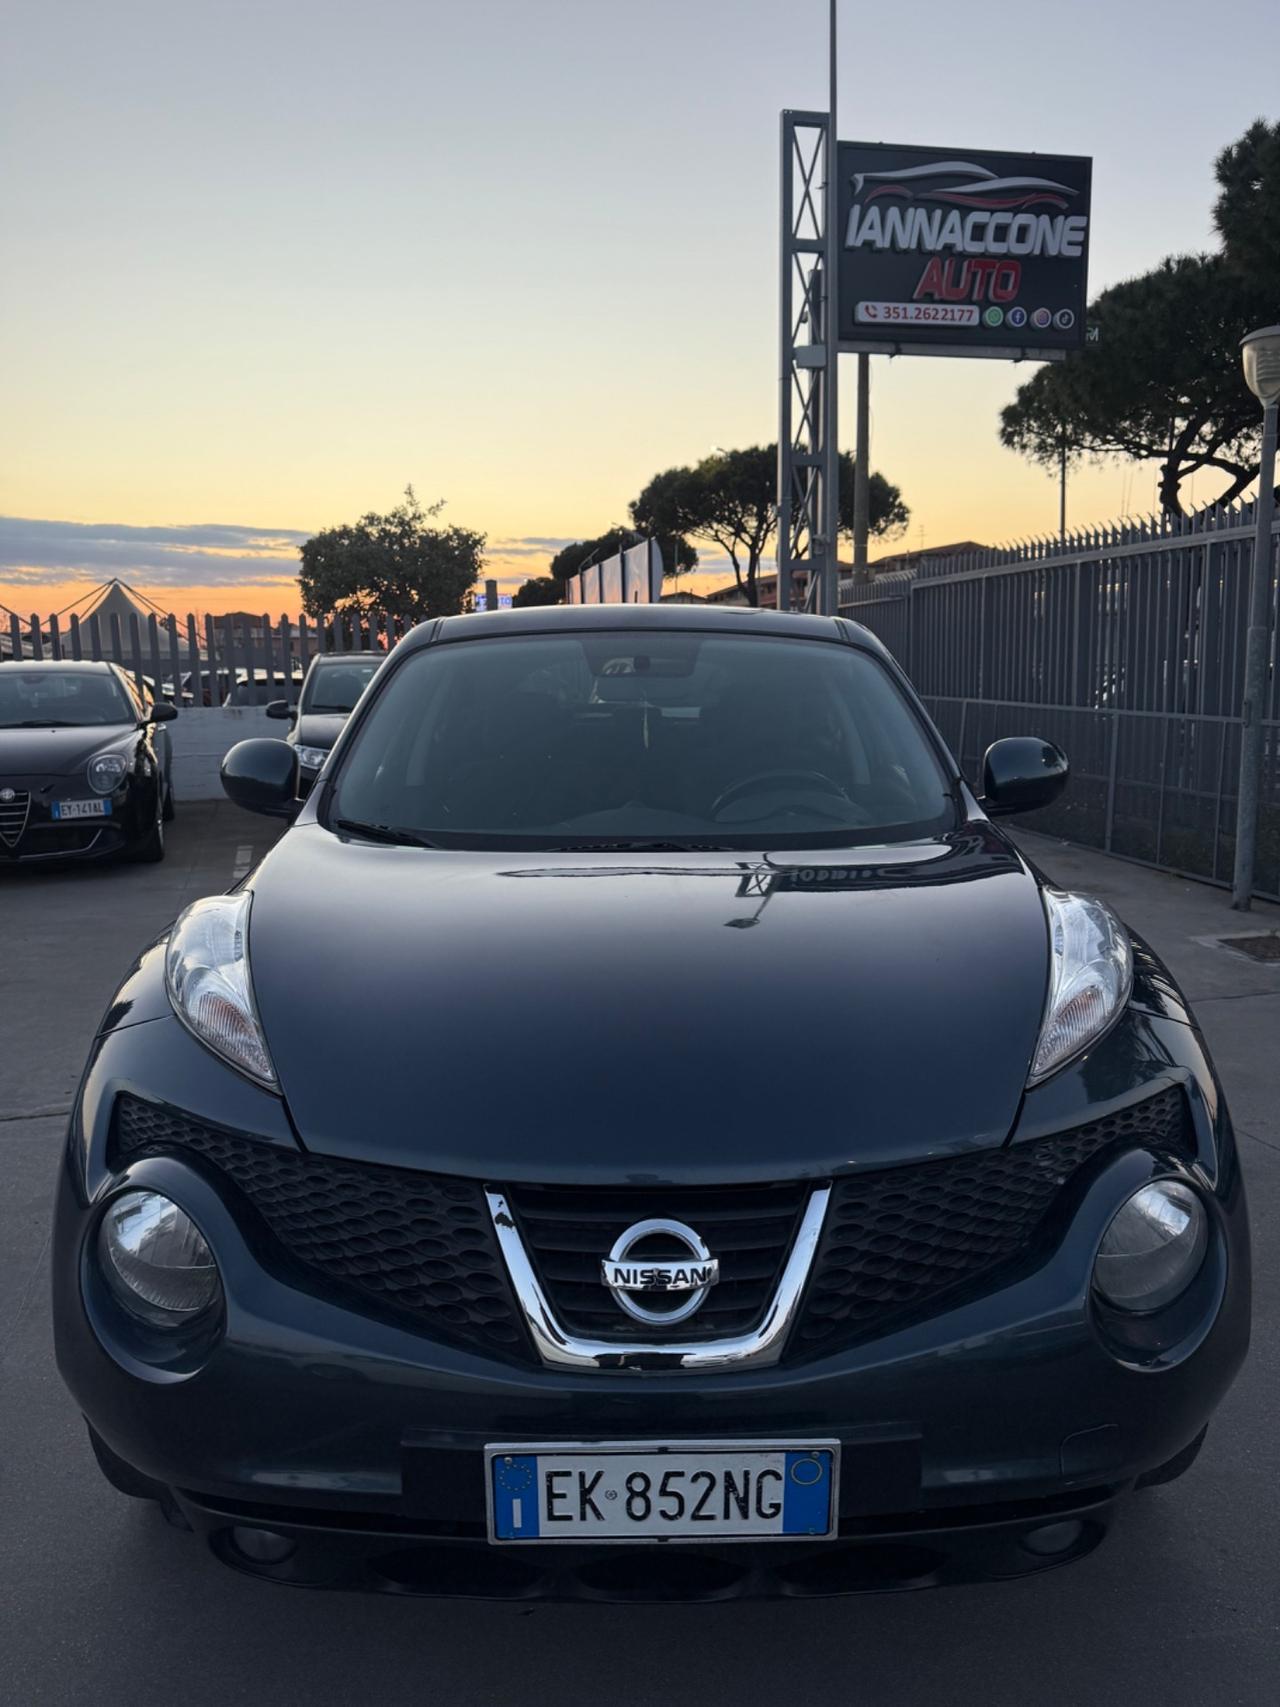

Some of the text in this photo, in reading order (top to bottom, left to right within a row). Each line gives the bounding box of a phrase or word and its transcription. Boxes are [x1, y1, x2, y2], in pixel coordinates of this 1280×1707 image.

[845, 204, 1087, 257] IANNACCONE
[912, 257, 1021, 301] AUTO
[883, 306, 974, 321] 351.2622177
[614, 1268, 707, 1285] NISSAN
